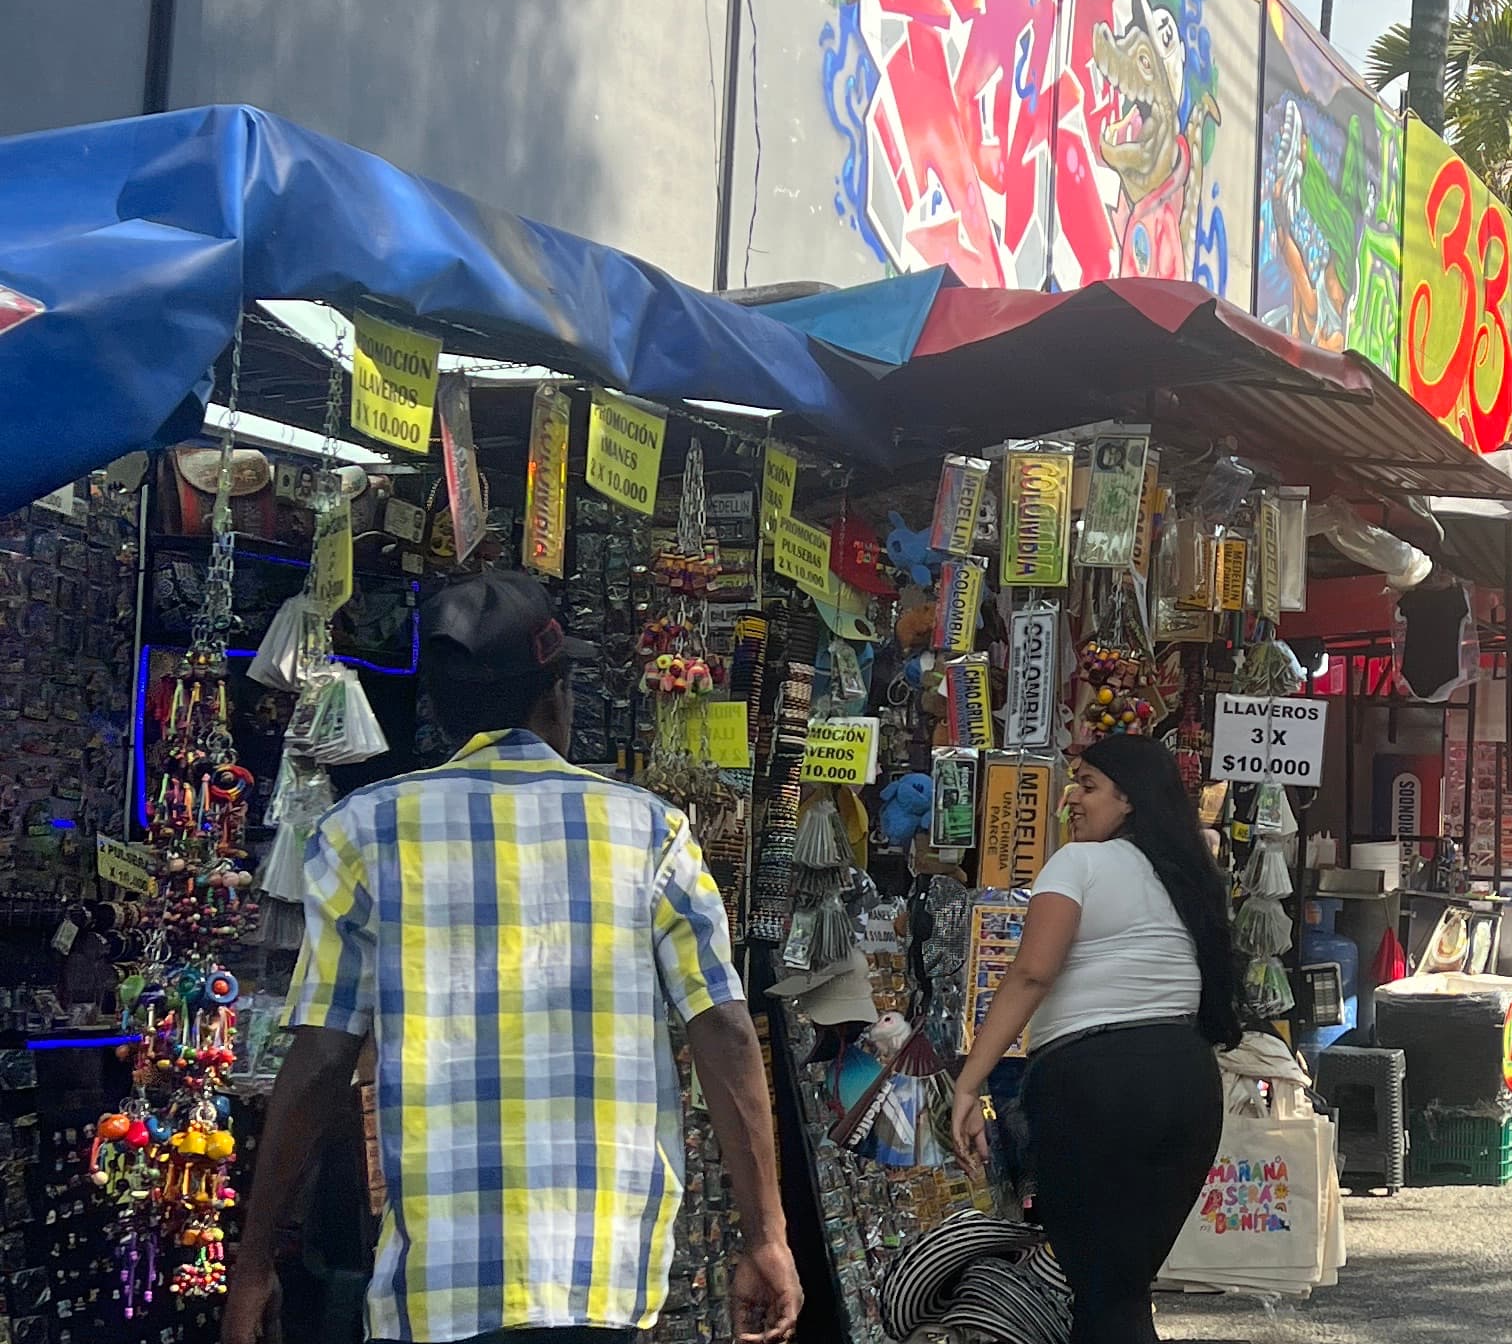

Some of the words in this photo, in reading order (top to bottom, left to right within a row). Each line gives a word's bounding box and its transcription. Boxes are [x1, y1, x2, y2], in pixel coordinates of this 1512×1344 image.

[357, 373, 418, 410] LLAVEROS
[372, 409, 421, 444] 10.000
[593, 403, 659, 450] PROMOCIÓN
[607, 466, 648, 505] 10.000
[951, 473, 977, 553] MEDELLIN
[794, 563, 825, 589] 10.000
[949, 568, 970, 646] COLOMBIA
[965, 669, 979, 699] CHAO
[1020, 623, 1043, 735] COLOMBIA
[967, 700, 985, 747] GRILLAS
[1223, 701, 1319, 721] LLAVEROS
[807, 725, 866, 744] MOCIÓN
[1251, 727, 1264, 744] 3
[1271, 729, 1287, 746] X
[804, 764, 857, 782] 10.000
[1222, 754, 1311, 777] $10.000
[1001, 791, 1013, 816] UNA
[987, 806, 1000, 855] PARCE
[999, 821, 1011, 870] CHIMBA
[1010, 772, 1038, 889] MEDELLIN
[1207, 1159, 1289, 1185] MAÑANA
